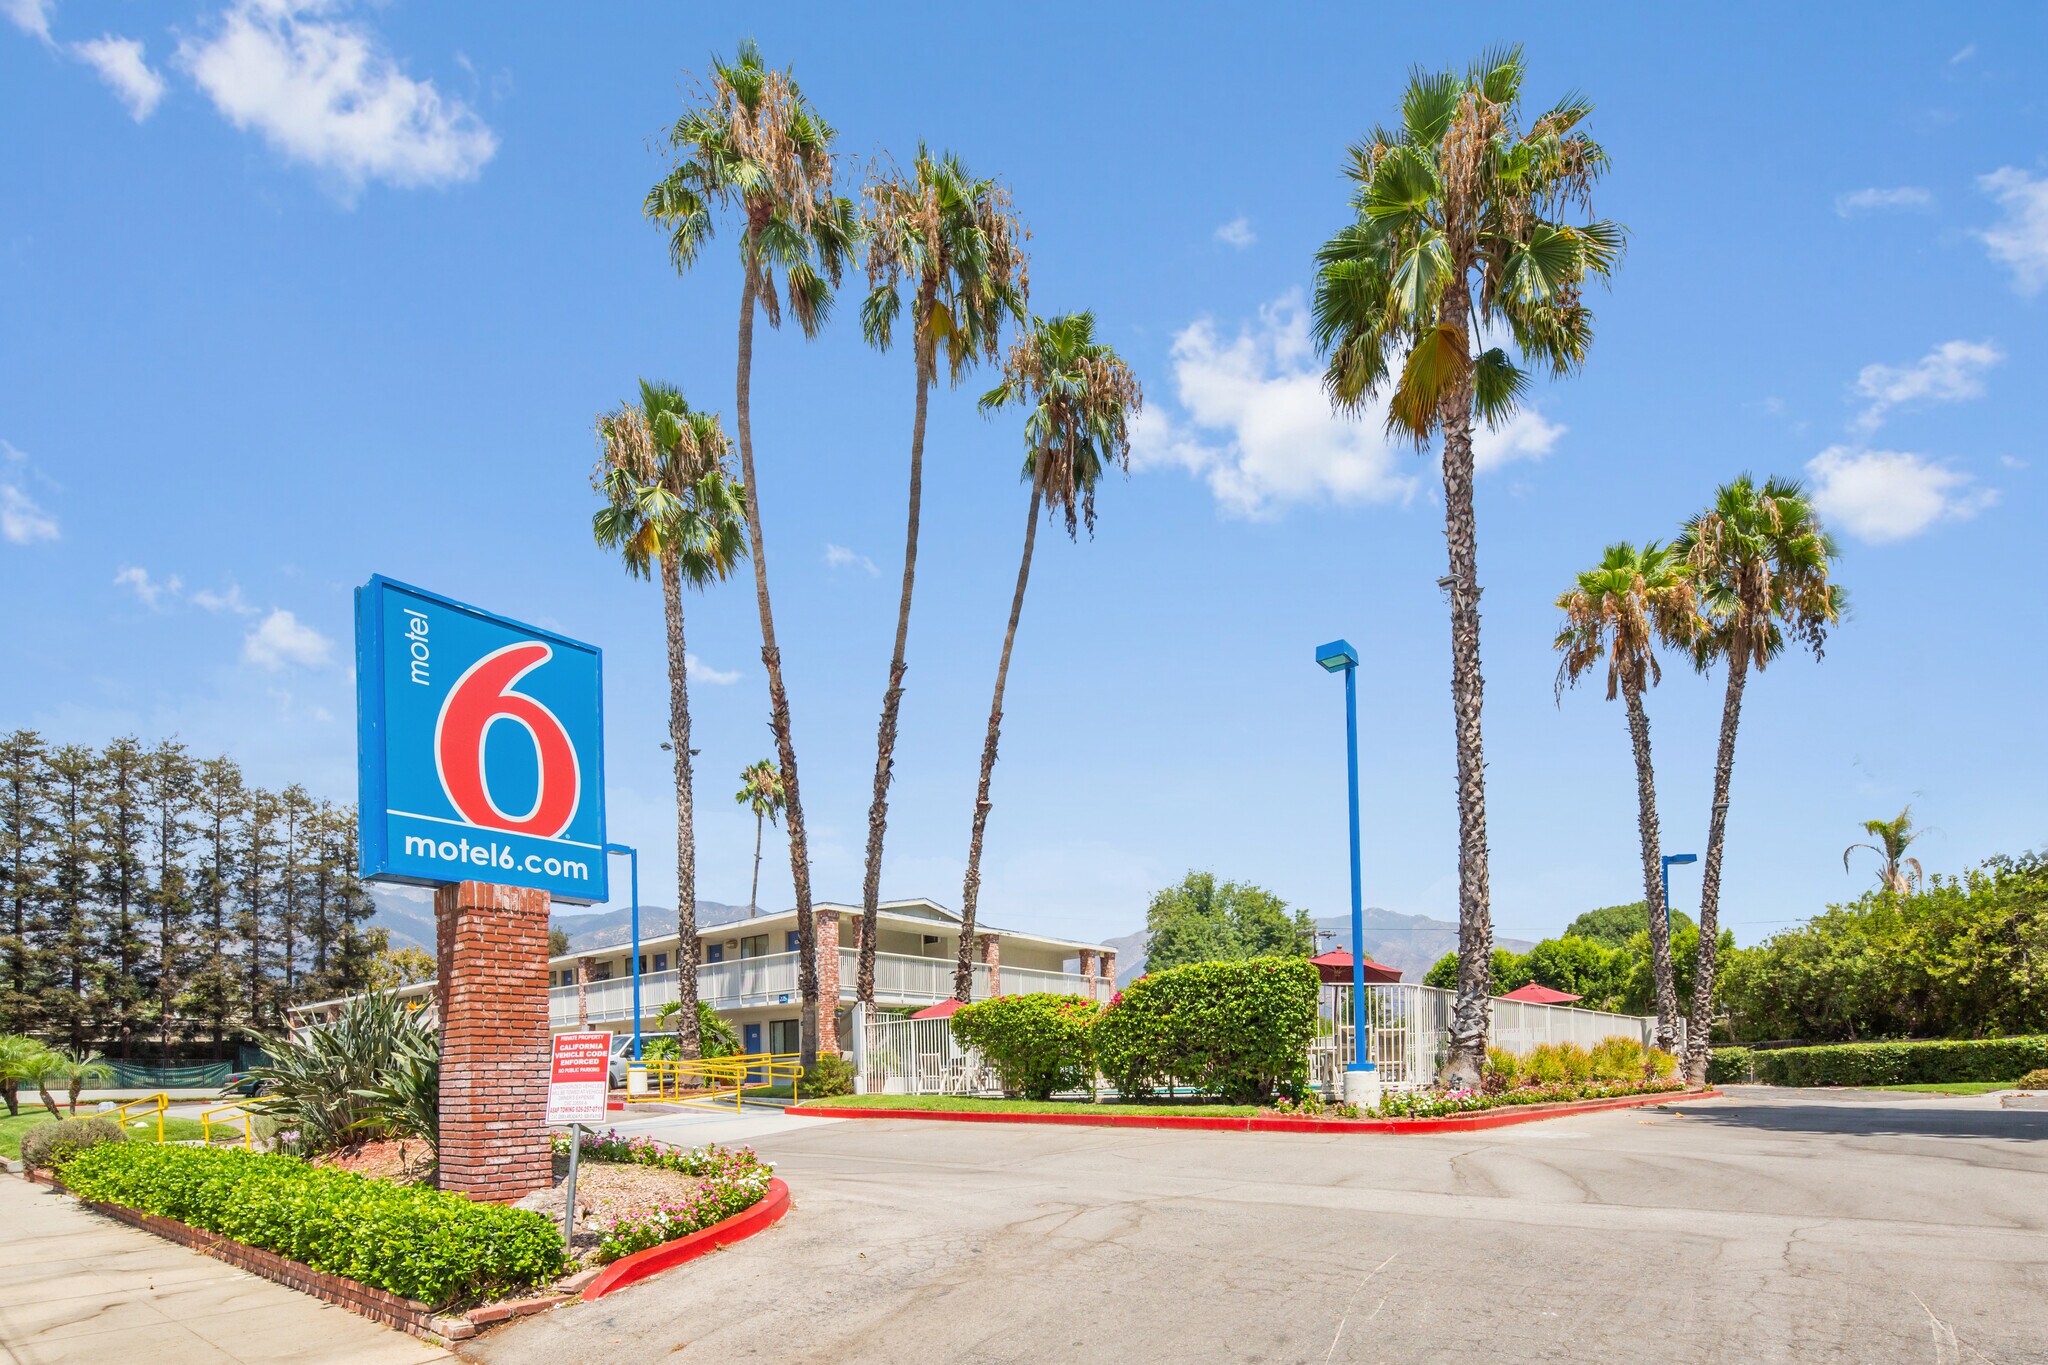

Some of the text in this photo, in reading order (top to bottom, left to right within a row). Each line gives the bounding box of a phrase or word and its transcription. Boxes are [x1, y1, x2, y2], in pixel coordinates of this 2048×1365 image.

[403, 608, 430, 686] motel
[434, 640, 581, 841] 6
[405, 835, 589, 881] motel6.com
[555, 1051, 585, 1059] VEHICLE
[559, 1043, 604, 1051] CALIFORNIA
[560, 1058, 599, 1066] ENFORCED
